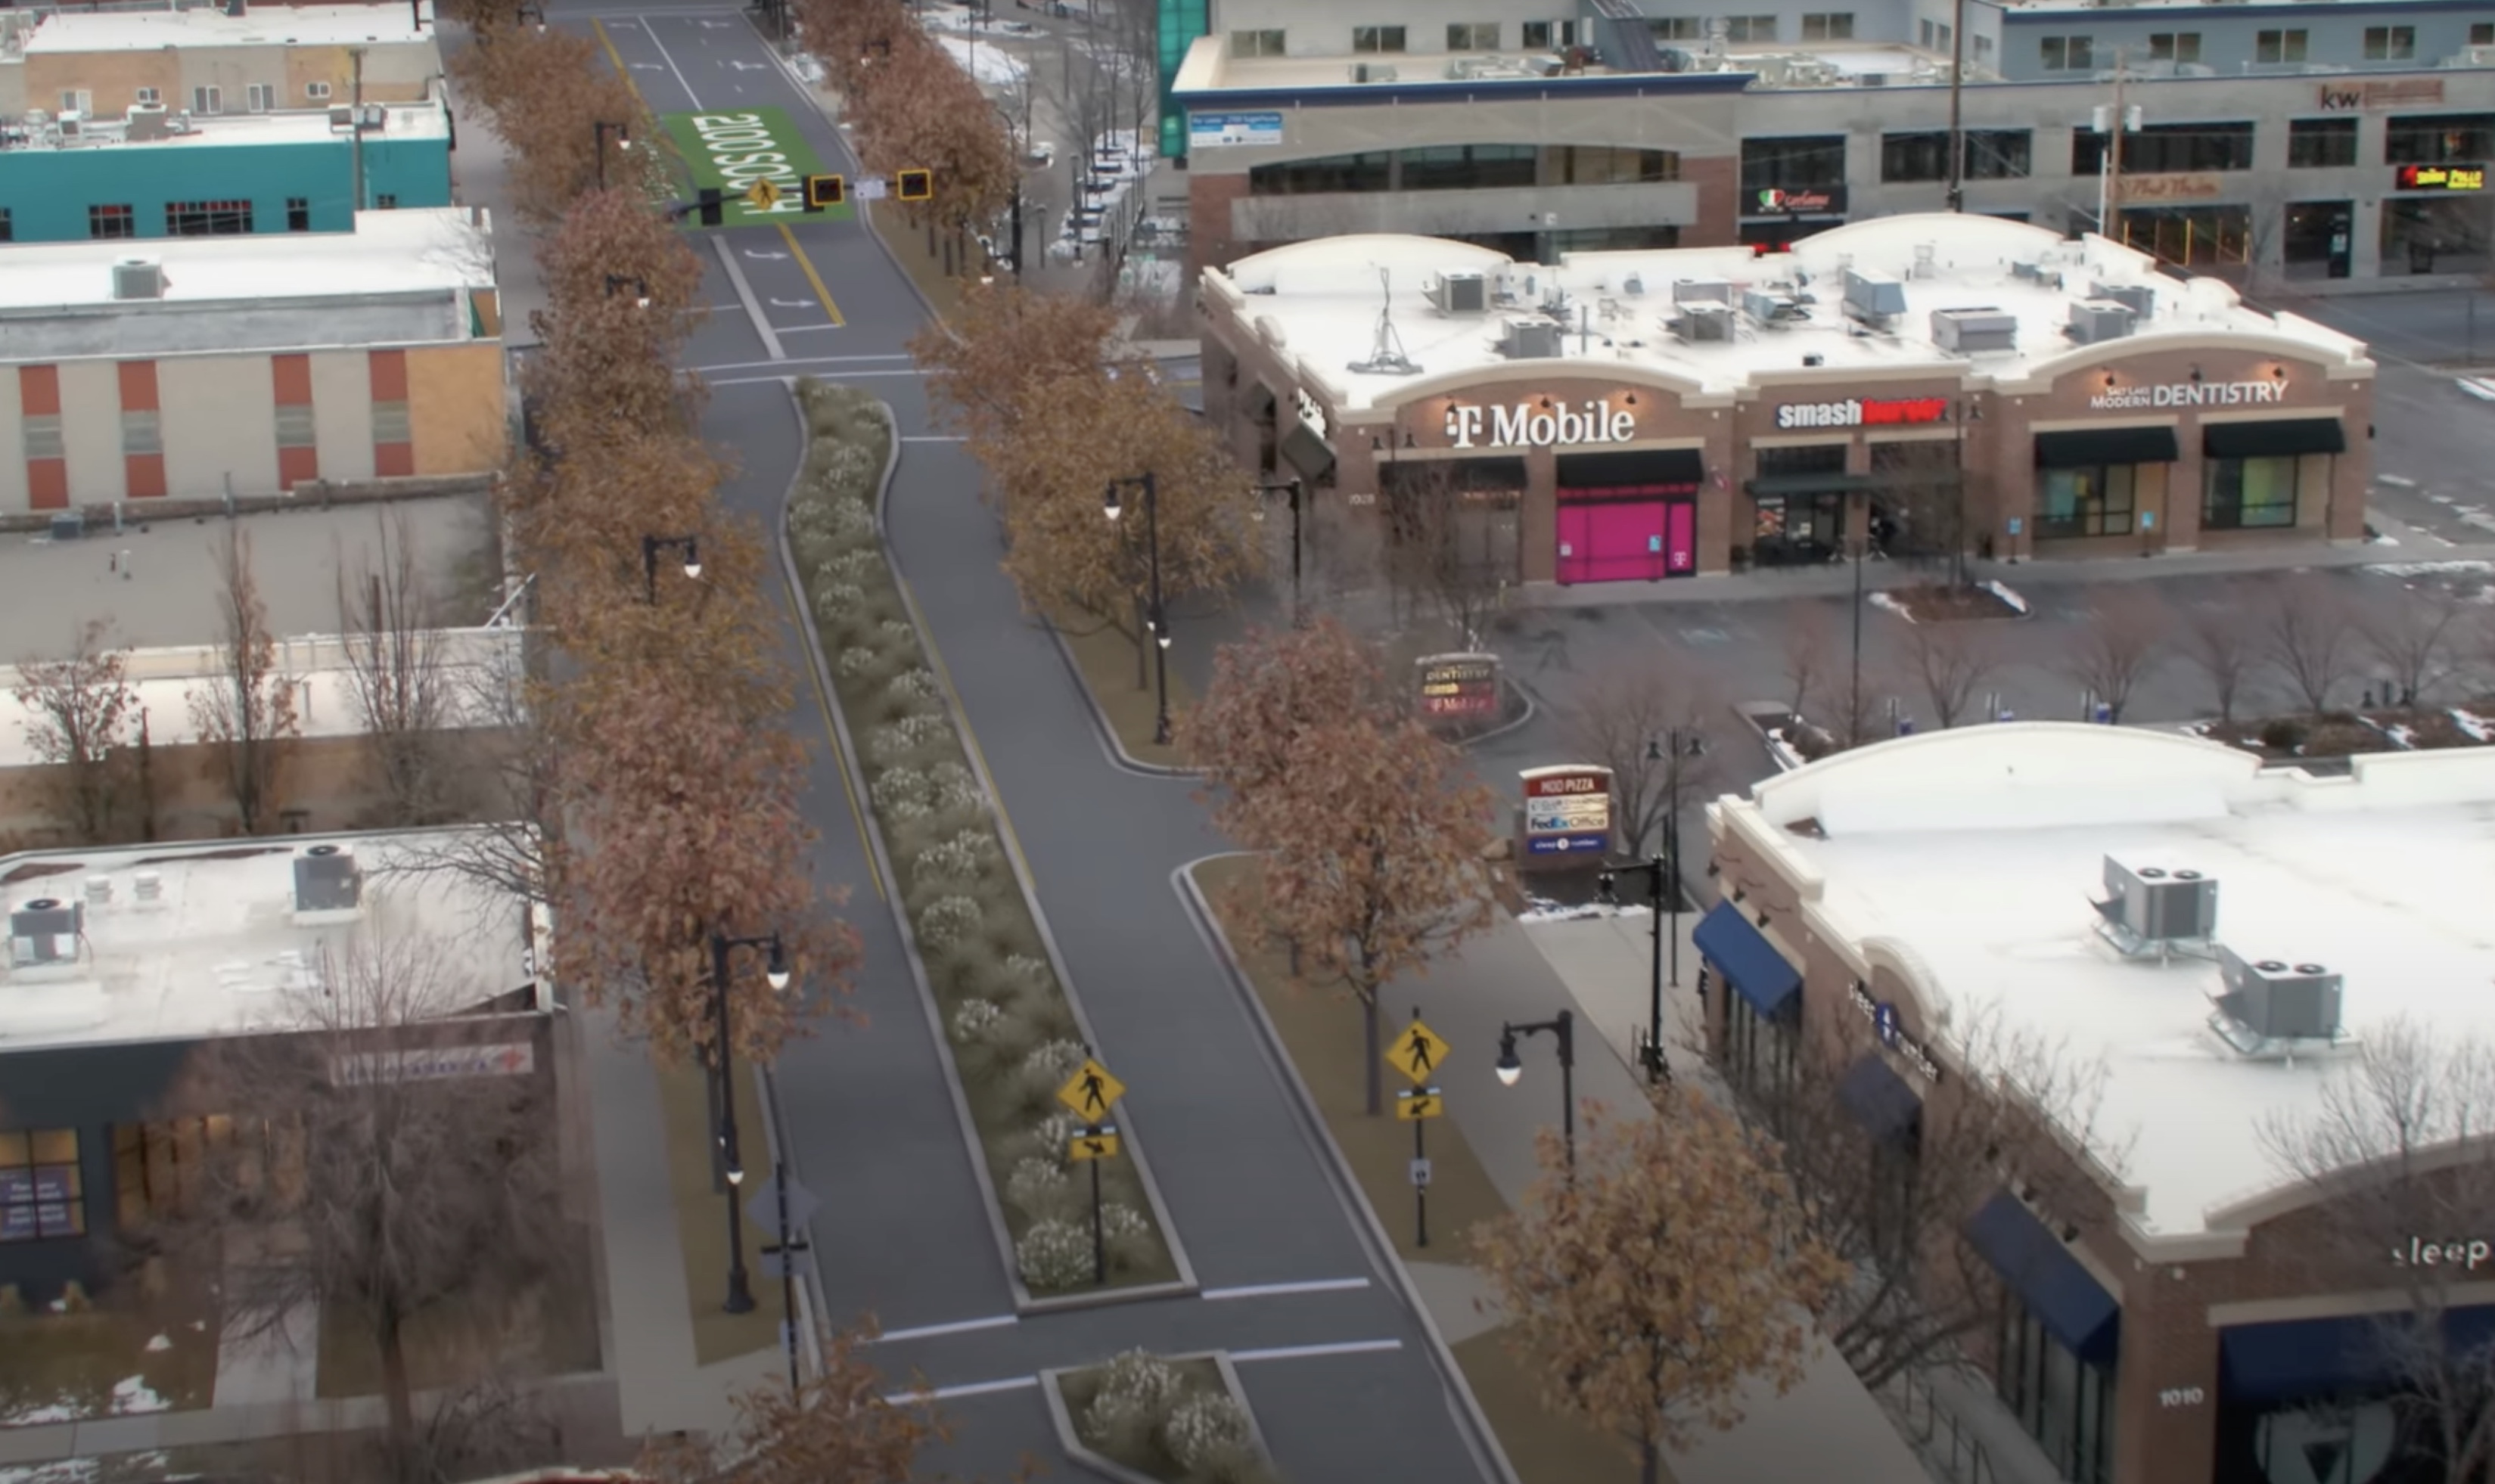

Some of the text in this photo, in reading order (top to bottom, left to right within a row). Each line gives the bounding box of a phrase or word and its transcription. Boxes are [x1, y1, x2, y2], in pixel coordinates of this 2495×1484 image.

[2321, 84, 2360, 110] kw
[691, 113, 777, 152] 2100
[2153, 380, 2289, 407] DENTISTRY
[1565, 778, 1595, 793] PIZZA
[1531, 817, 1569, 830] FedEx
[2158, 1386, 2204, 1408] 1010
